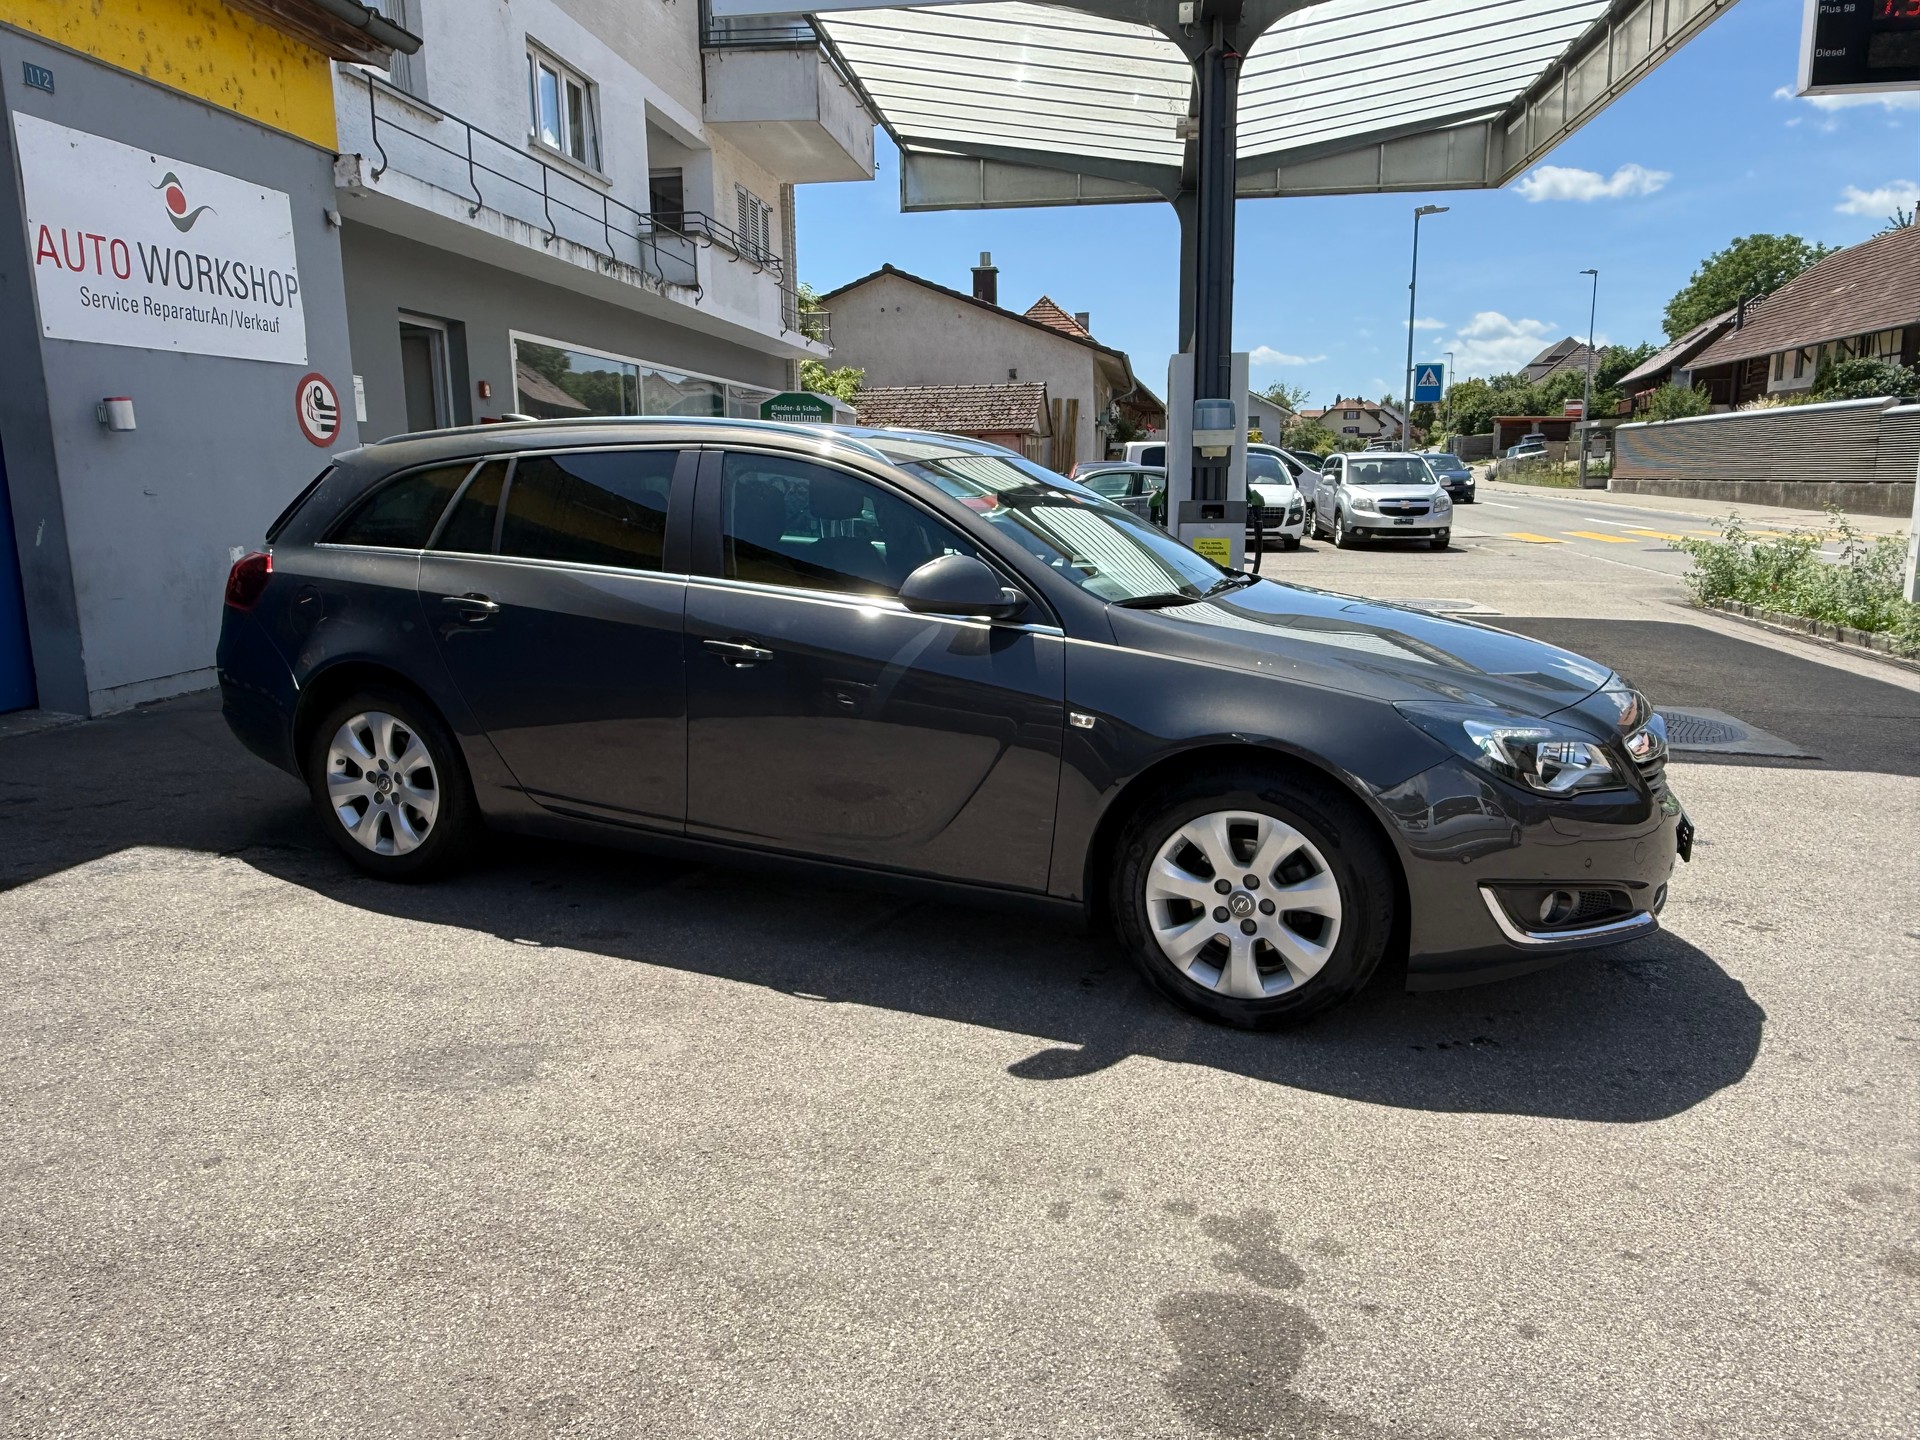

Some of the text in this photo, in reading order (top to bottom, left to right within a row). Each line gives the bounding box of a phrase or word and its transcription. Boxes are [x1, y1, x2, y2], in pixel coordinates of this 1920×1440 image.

[1820, 4, 1856, 13] Plus 98
[1815, 47, 1846, 57] Diesel
[29, 67, 51, 88] 112
[36, 224, 299, 309] AUTO WORKSHOP
[79, 286, 139, 314] Service
